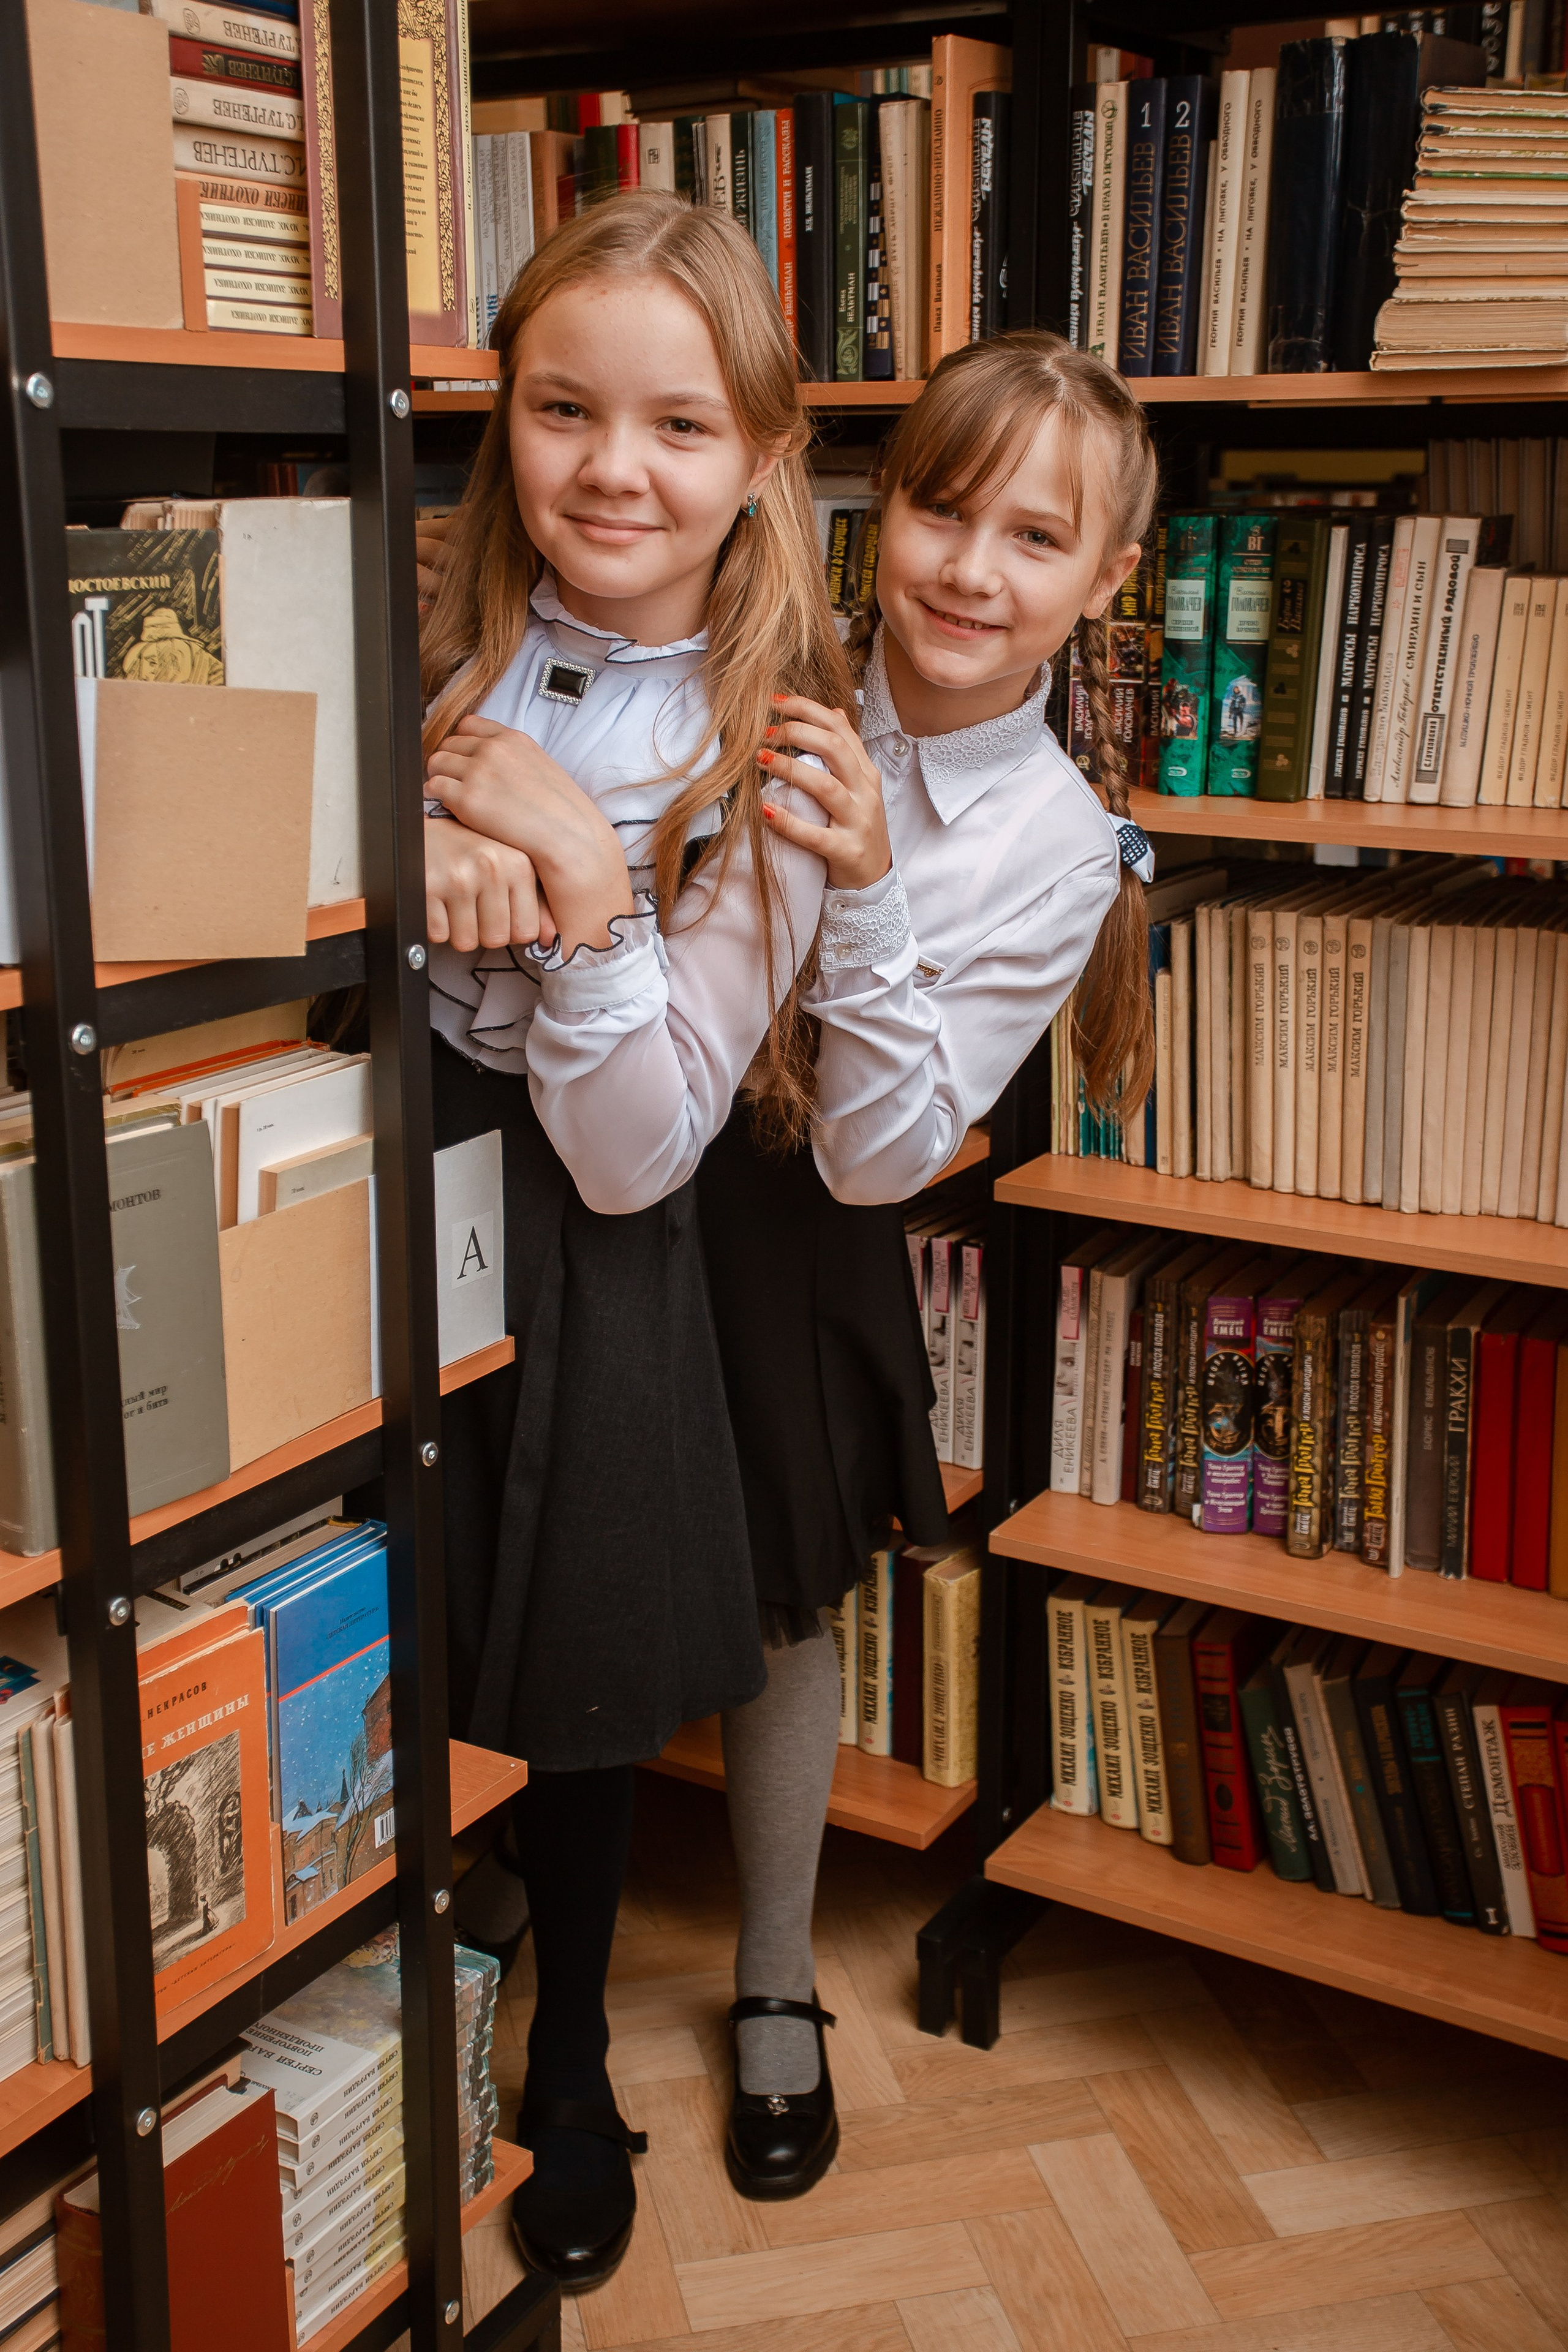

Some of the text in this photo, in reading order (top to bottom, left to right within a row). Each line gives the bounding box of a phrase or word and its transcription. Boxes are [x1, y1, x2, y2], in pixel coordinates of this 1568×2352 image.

[1140, 101, 1153, 128] 1
[1174, 100, 1190, 128] 2
[1220, 102, 1232, 161] ОБВОДНОГО
[1250, 99, 1264, 159] ОБВОДНОГО
[192, 141, 281, 174] ТУРГЕНЕВ
[780, 119, 791, 175] РАССКАЗЫ
[1082, 110, 1096, 195] БЕСЕДЫ
[734, 149, 748, 209] ЖИЗНЬ
[782, 190, 793, 239] ПОВЕСТИ
[1217, 228, 1226, 243] НА
[1244, 227, 1254, 241] НА
[1095, 178, 1113, 338] ИВАН ВАСИЛЬЕВ КРАЮ
[1123, 141, 1156, 360] ИВАН ВАСИЛЬЕВ
[1156, 134, 1192, 354] ИВАН ВАСИЛЬЕВ
[846, 272, 856, 322] ВЕЛЬТМАН
[933, 263, 943, 303] Васильев
[1212, 257, 1223, 305] ВАСИЛЬЕВ
[1238, 256, 1250, 303] ВАСИЛЬЕВ
[933, 307, 943, 333] Павел
[1210, 309, 1220, 349] ГЕОРГИЙ
[1235, 307, 1246, 347] ГЕОРГИЙ
[1120, 595, 1137, 616] МИР
[1347, 542, 1367, 625] НАРКОМПРОСА
[1370, 544, 1390, 626] НАРКОМПРОСА
[1340, 633, 1358, 687] МАТРОСЫ
[1430, 554, 1461, 713] ОТВЕТСТВЕННЫЙ РЯДОВОЙ
[1362, 635, 1379, 689] МАТРОСЫ
[1389, 560, 1427, 788] Александр Говоров СМИРДИН СЫН
[1074, 685, 1085, 732] ВАСИЛИЙ
[1114, 687, 1125, 735] ВАСИЛИЙ
[1123, 687, 1134, 743] ГОЛОВАЧЕВ
[1149, 688, 1160, 736] ВАСИЛИЙ
[1496, 689, 1513, 780] ФЕДОР ГЛАДКОВ ЦЕМЕНТ
[1517, 690, 1534, 782] ФЕДОР ГЛАДКОВ ЦЕМЕНТ
[1549, 690, 1565, 783] ФЕДОР ГЛАДКОВ ЦЕМЕНТ
[1253, 963, 1265, 1066] МАКСИМ ГОРЬКИЙ
[1278, 963, 1289, 1068] МАКСИМ ГОРЬКИЙ
[1305, 968, 1317, 1072] МАКСИМ ГОРЬКИЙ
[1327, 967, 1340, 1073] МАКСИМ ГОРЬКИЙ
[1350, 971, 1364, 1077] МАКСИМ ГОРЬКИЙ
[456, 1225, 489, 1281] А
[1213, 1325, 1243, 1336] ЕМЕЦ
[1144, 1313, 1167, 1466] Таня Гроттер ПОСОХ ВОЛХВОВ
[1187, 1358, 1197, 1378] ЛОКОН
[1447, 1357, 1468, 1432] ГРАКХИ
[938, 1379, 950, 1444] ЕНИКЕЕВА
[956, 1398, 965, 1434] ДИЛЯ
[965, 1387, 976, 1452] ЕНИКЕЕВА
[1292, 1355, 1316, 1510] Таня Гроттер ЛОКОН АФРОДИТЫ
[1337, 1343, 1362, 1504] Таня Гроттер ПОСОХ ВОЛХВОВ
[1423, 1415, 1433, 1450] БОРИС
[1053, 1420, 1064, 1458] ДИЛЯ
[1063, 1408, 1077, 1474] ЕНИКЕЕВА
[339, 1607, 367, 1624] Издательство
[148, 1681, 208, 1719] НЕКРАСОВ
[862, 1632, 880, 1725] МИХАИЛ ЗОЩЕНКО
[1055, 1610, 1079, 1786] МИХАИЛ ЗОЩЕНКО ИЗБРАННОЕ
[160, 1694, 249, 1749] ЖЕНЩИНЫ
[1092, 1619, 1124, 1799] МИХАИЛ ЗОЩЕНКО ИЗБРАННОЕ
[1129, 1633, 1164, 1815] МИХАИЛ ЗОЩЕНКО ИЗБРАННОЕ
[1444, 1707, 1476, 1810] СТЕПАН РАЗИН
[1481, 1719, 1513, 1819] ДЕМОНТАЖ
[246, 2028, 313, 2057] ПОВТОРЕНИЕ
[252, 2022, 325, 2052] ПРОЙДЕННОГ
[343, 2068, 375, 2097] БАРУЗДИН
[344, 2089, 376, 2119] БАРУЗДИН
[327, 2139, 361, 2170] БАРУЗДИН
[338, 2115, 371, 2146] БАРУЗДИН
[326, 2166, 360, 2197] БАРУЗДИН
[328, 2184, 361, 2215] БАРУЗДИН
[337, 2221, 371, 2253] БАРУЗДИН
[339, 2201, 371, 2233] БАРУЗДИН
[328, 2260, 361, 2293] БАРУЗДИН
[331, 2282, 363, 2314] БАРУЗДИН
